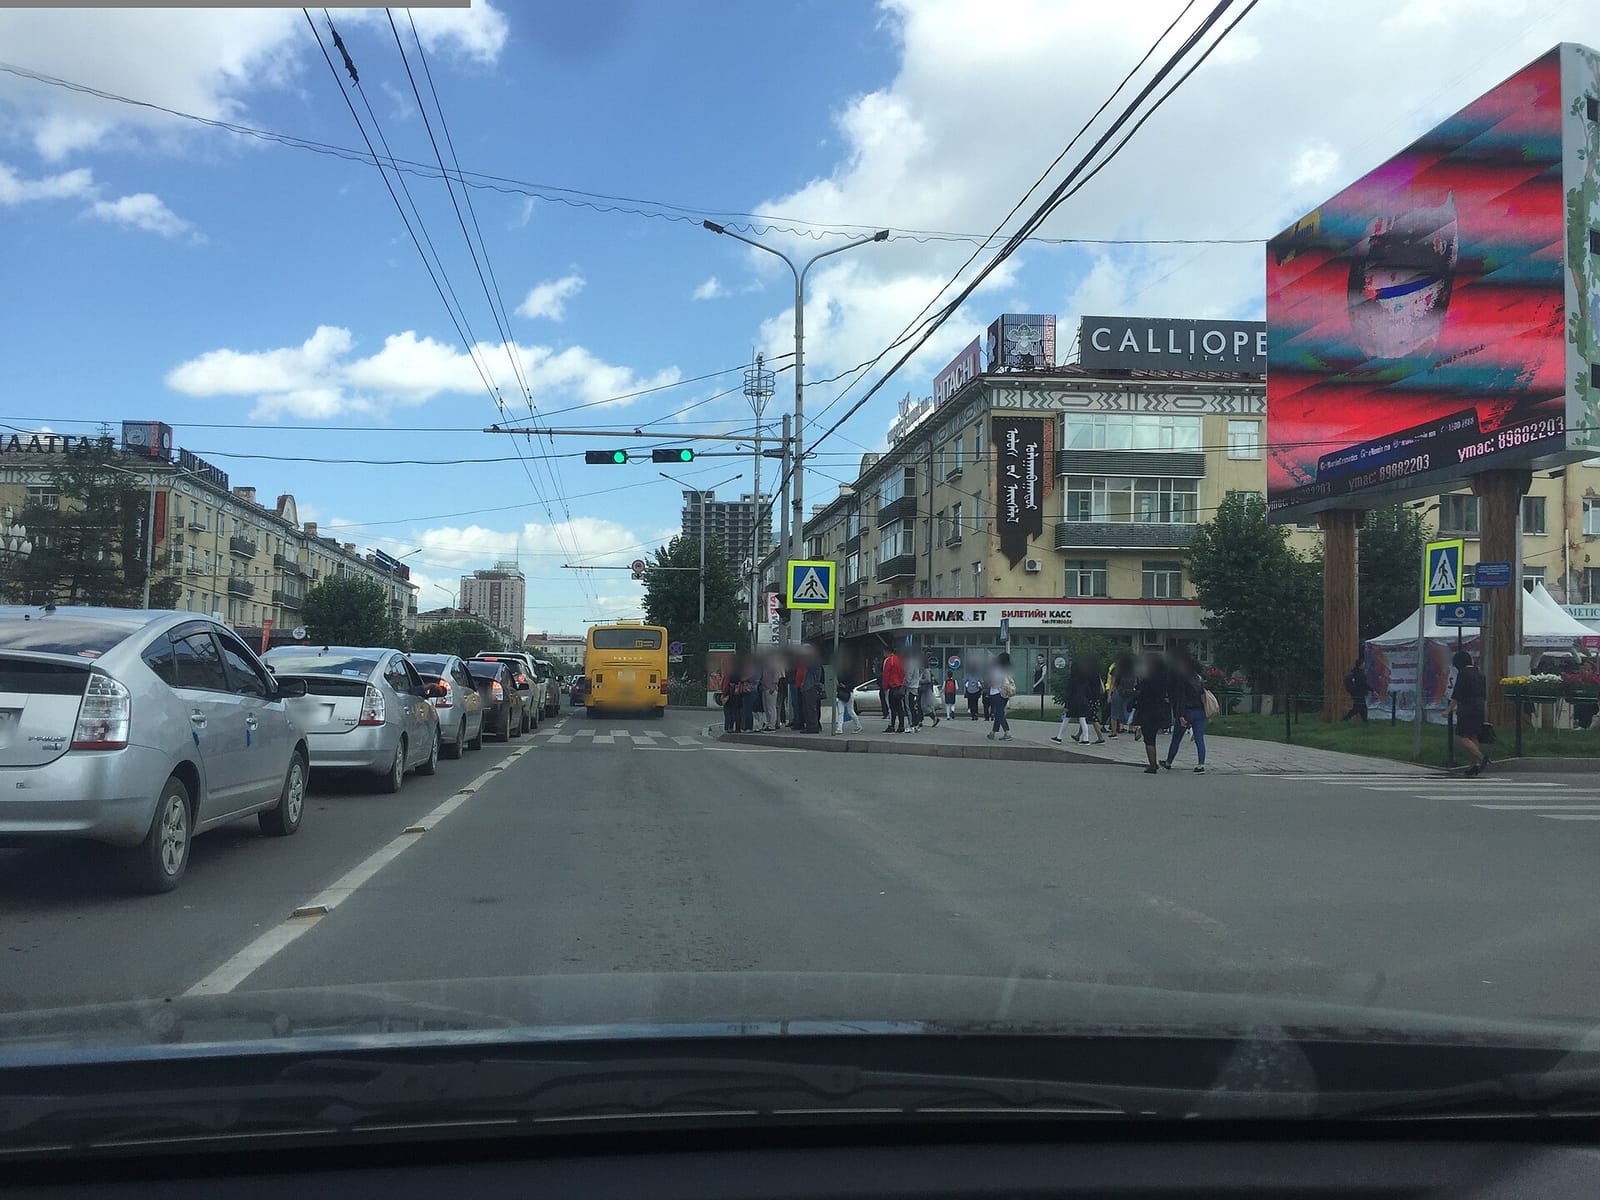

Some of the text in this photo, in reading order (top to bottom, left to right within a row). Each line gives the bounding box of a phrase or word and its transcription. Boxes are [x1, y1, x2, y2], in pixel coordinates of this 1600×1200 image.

[1091, 327, 1267, 356] CALLIOPE
[936, 353, 976, 408] HITACHI
[1001, 609, 1072, 618] БИЛЕТИЙН КАСС
